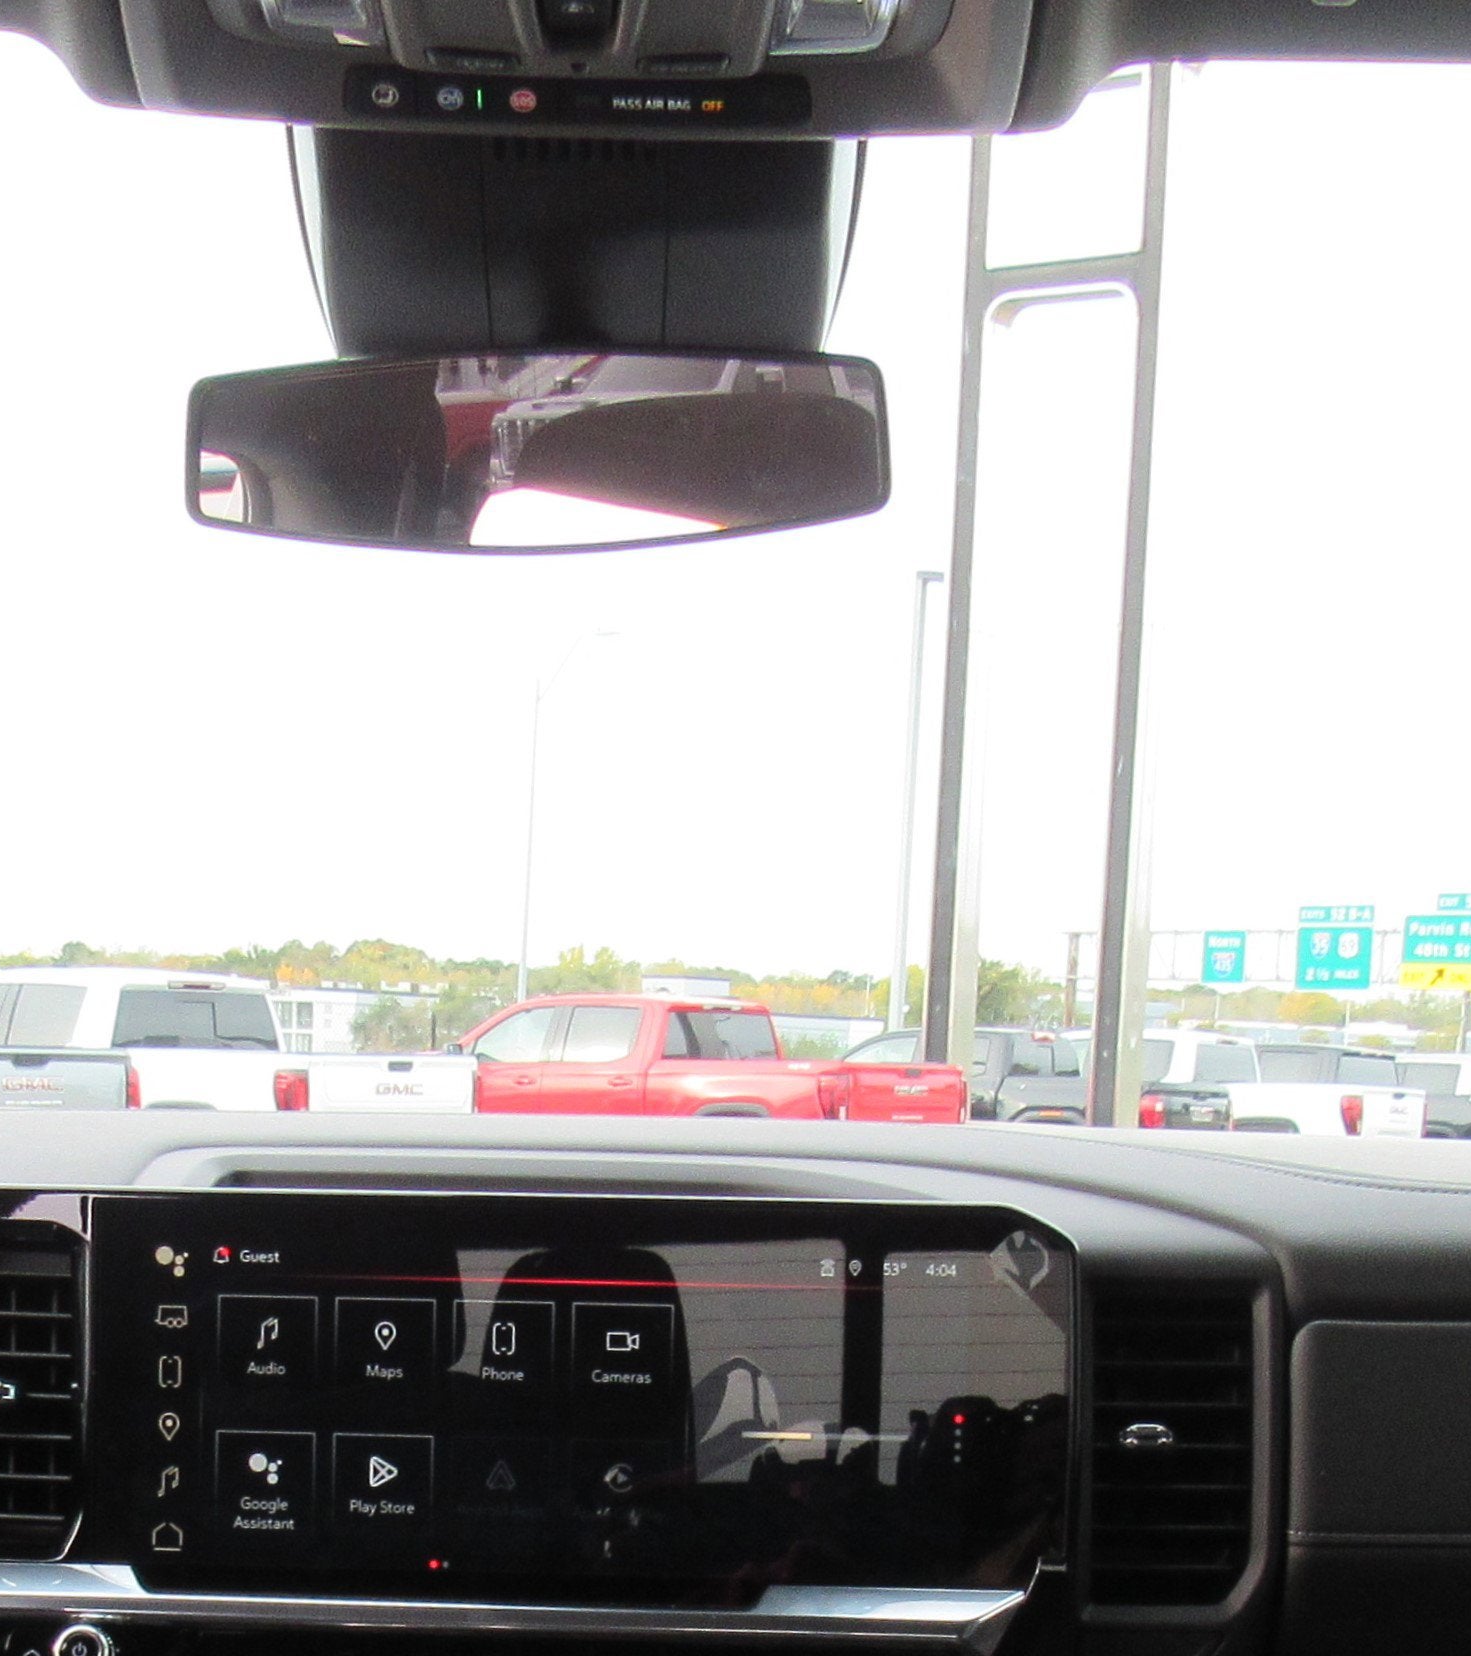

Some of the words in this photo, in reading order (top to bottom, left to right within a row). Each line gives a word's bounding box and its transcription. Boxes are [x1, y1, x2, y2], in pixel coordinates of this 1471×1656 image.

[612, 97, 643, 111] PASS
[645, 97, 665, 111] AIR
[668, 98, 692, 111] BAG
[701, 99, 725, 112] OFF
[2, 1075, 64, 1092] GMC
[375, 1083, 424, 1096] GMC
[239, 1250, 280, 1265] Guest
[925, 1263, 957, 1277] 4:04
[246, 1361, 286, 1376] Audio
[365, 1363, 404, 1381] Maps
[481, 1366, 525, 1382] Phone
[591, 1369, 652, 1385] Cameras
[240, 1496, 289, 1514] Google
[348, 1499, 377, 1517] Play
[379, 1500, 415, 1515] Store
[232, 1515, 295, 1530] Assistant
